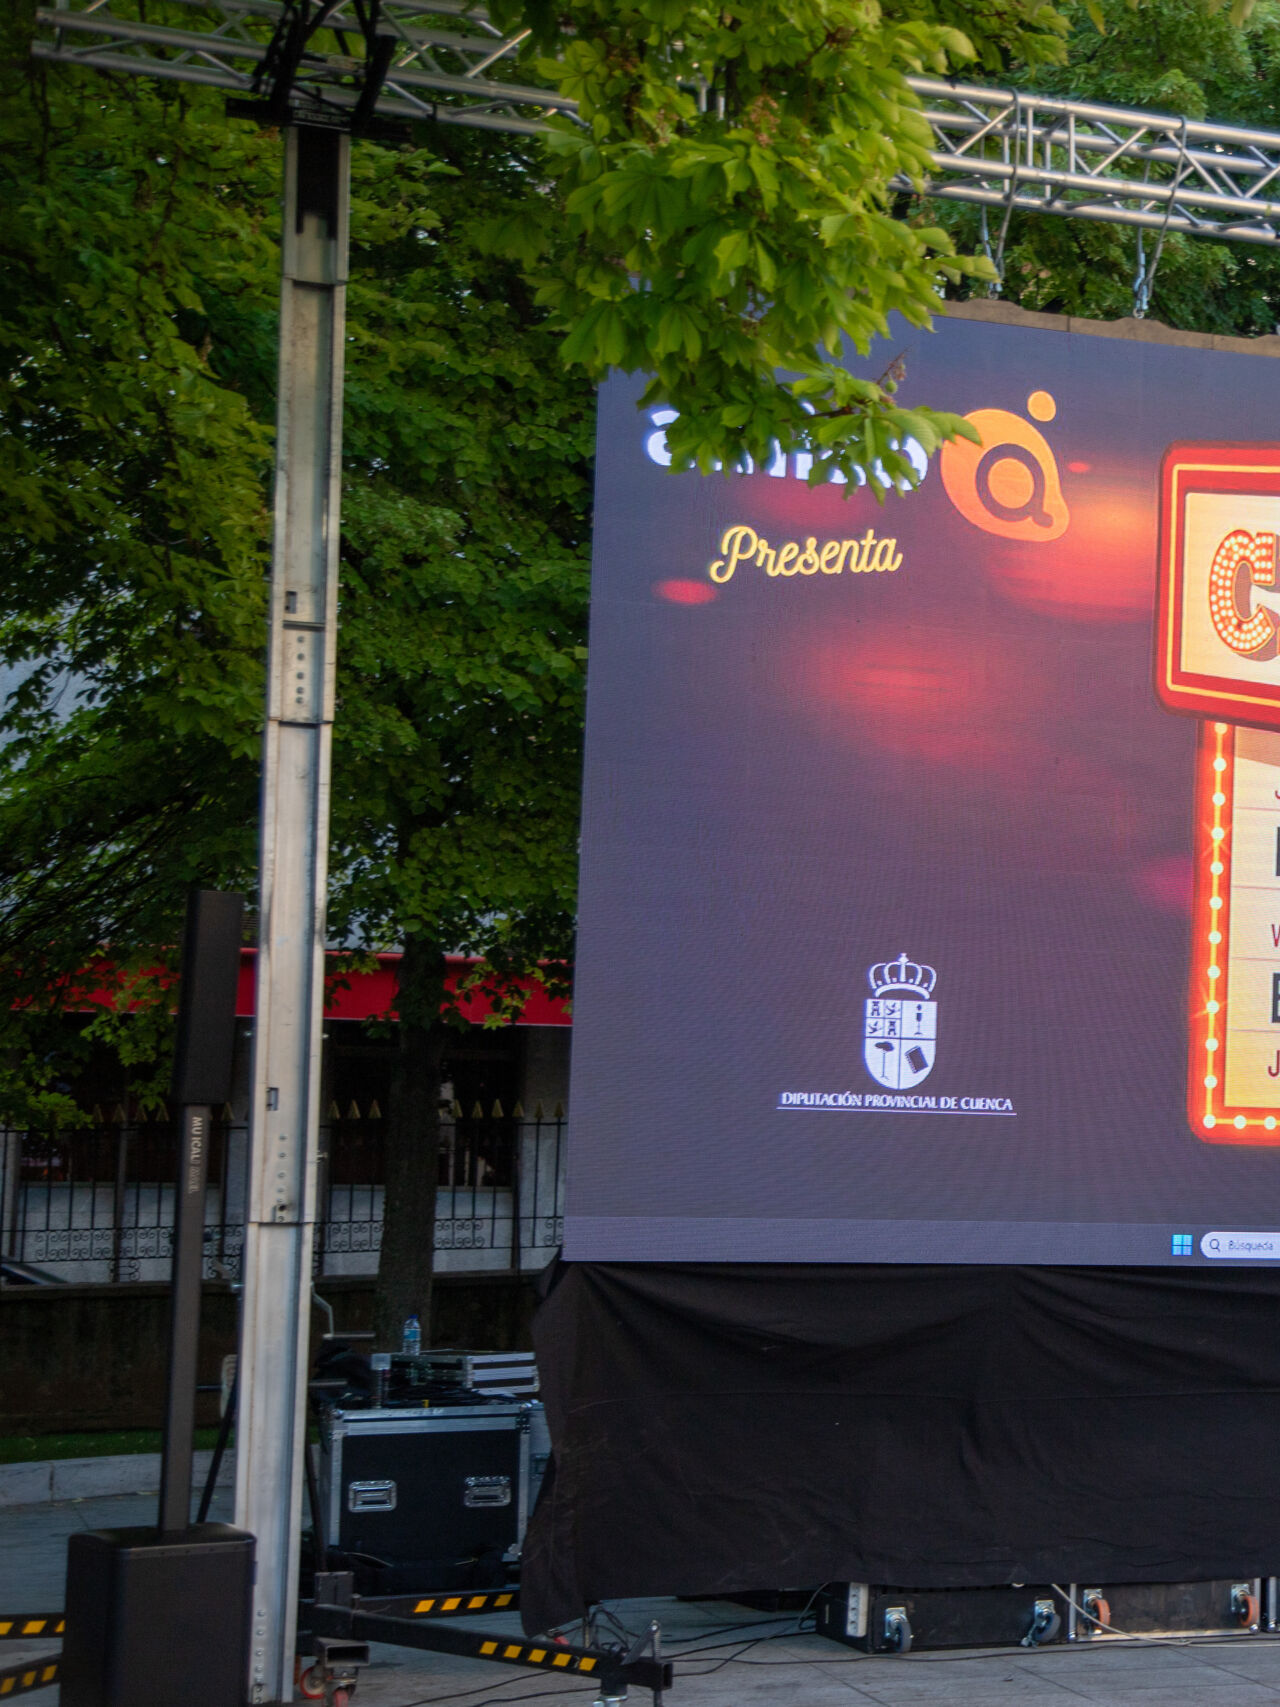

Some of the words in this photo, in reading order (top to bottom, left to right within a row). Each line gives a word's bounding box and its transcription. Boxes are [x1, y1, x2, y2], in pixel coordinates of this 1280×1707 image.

[710, 526, 903, 583] Presenta
[781, 1091, 862, 1106] DIPUTACIÓN
[864, 1094, 938, 1109] PROVINCIAL
[940, 1096, 959, 1110] DE
[960, 1097, 1014, 1111] CUENCA
[190, 1116, 203, 1161] MUICAL
